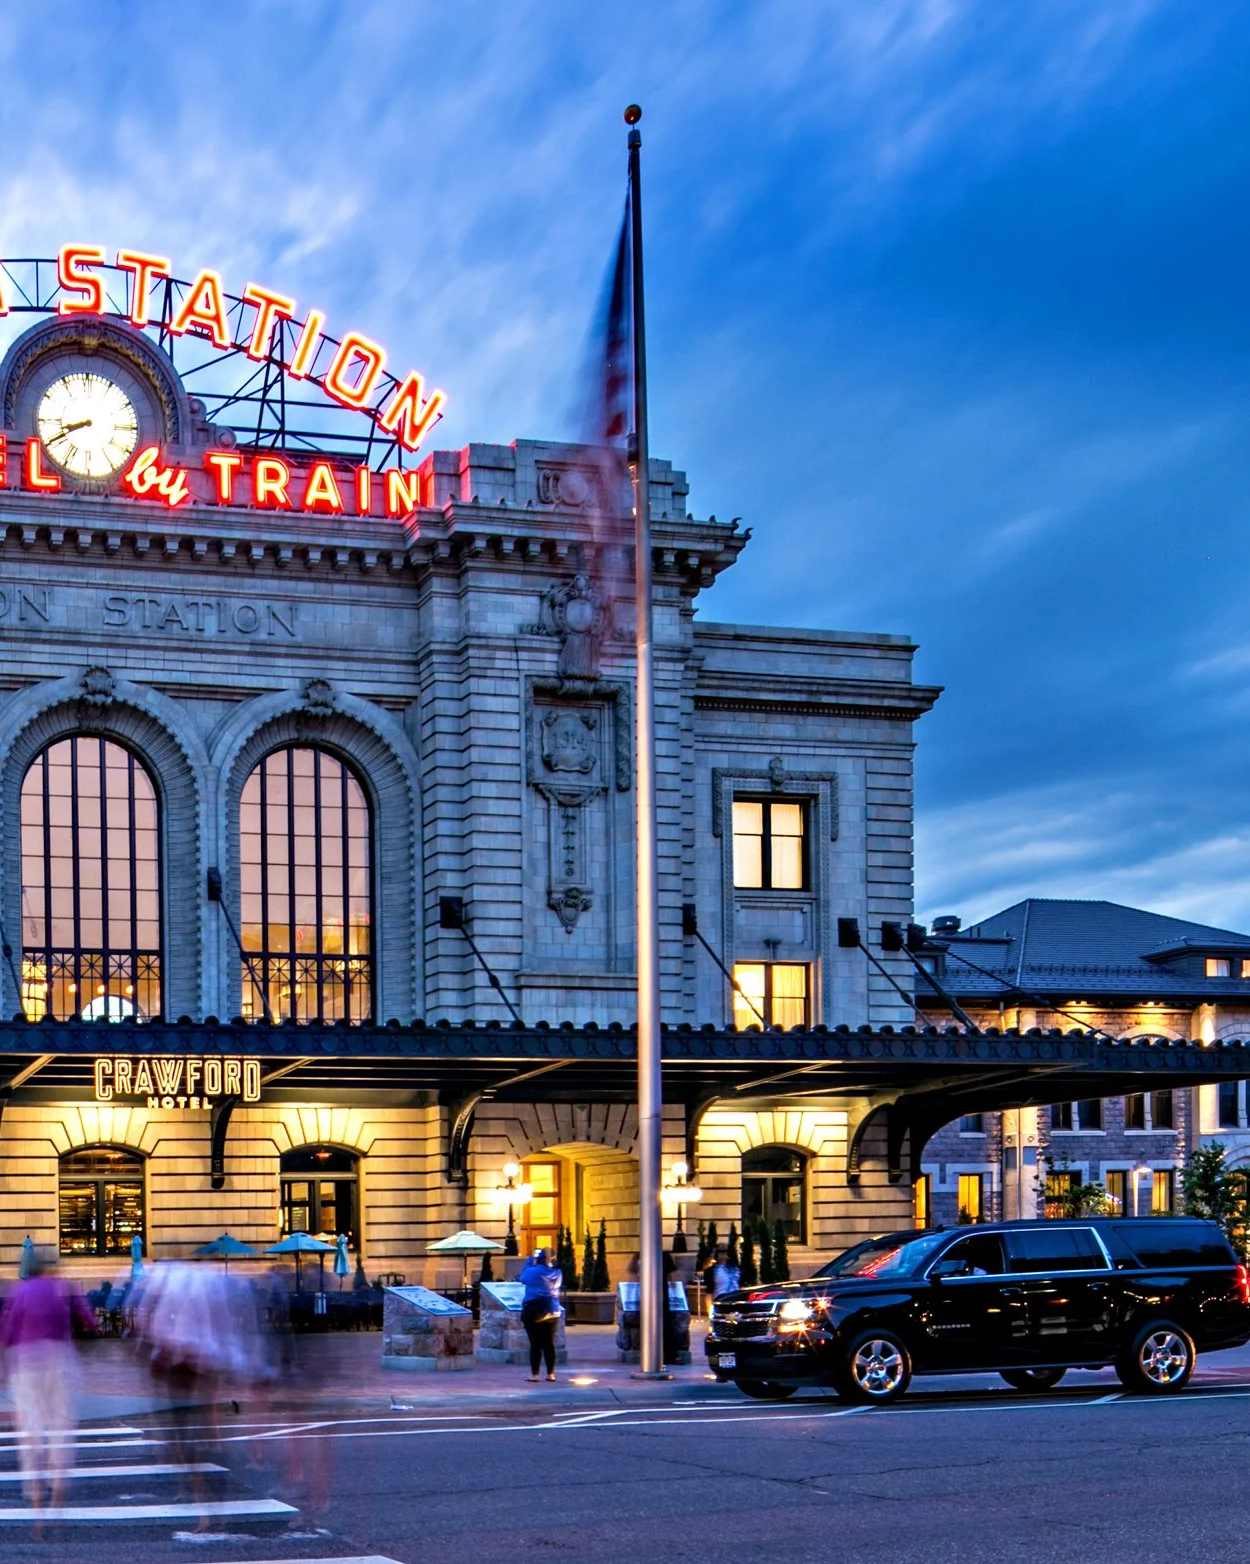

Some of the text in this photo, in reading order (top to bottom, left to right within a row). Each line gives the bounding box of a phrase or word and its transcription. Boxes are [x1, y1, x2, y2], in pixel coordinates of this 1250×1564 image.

[57, 243, 448, 453] STATION
[124, 446, 190, 507] by
[207, 452, 421, 519] TRAIN
[103, 596, 299, 638] STATION
[95, 1058, 261, 1102] CRAWFORD
[147, 1096, 213, 1110] HOTEL
